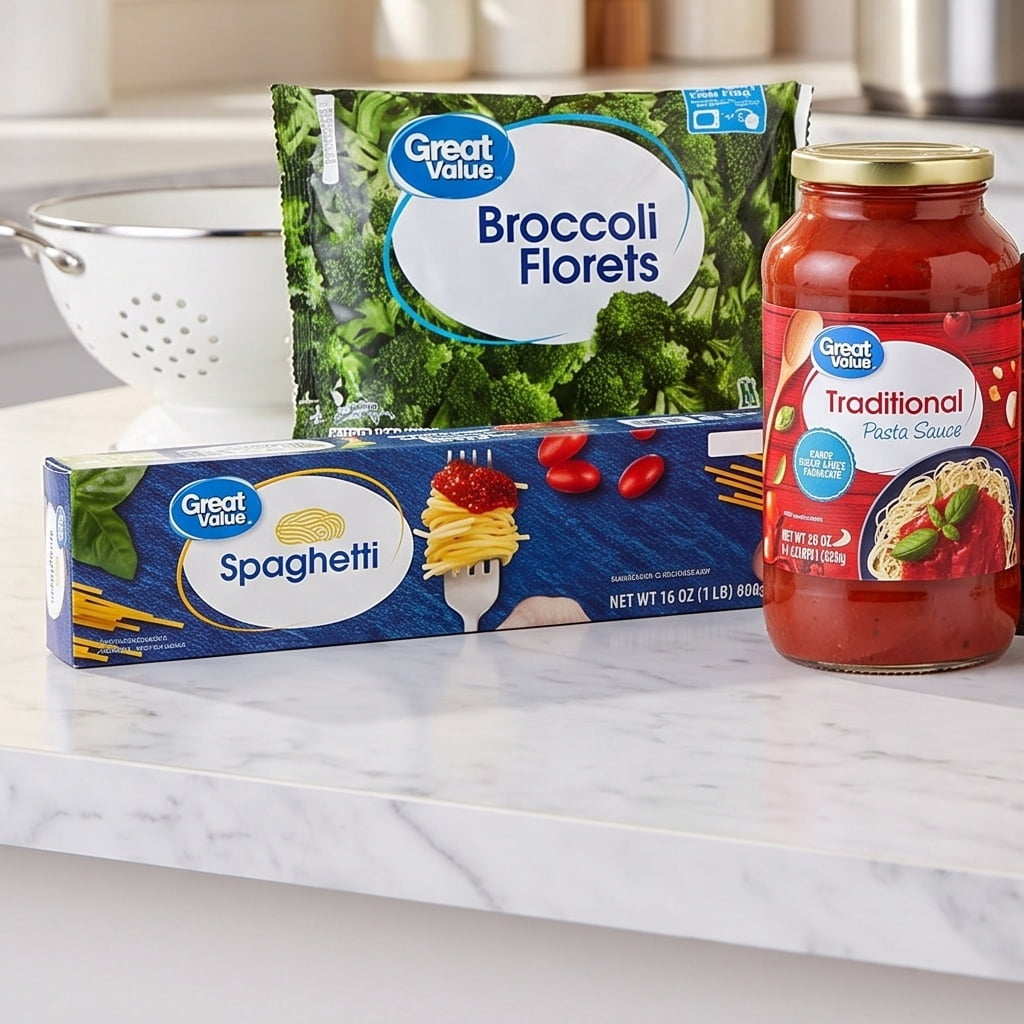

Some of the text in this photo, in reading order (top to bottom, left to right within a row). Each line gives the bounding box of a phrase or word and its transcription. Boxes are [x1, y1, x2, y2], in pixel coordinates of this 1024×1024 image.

[404, 132, 494, 162] Great
[426, 161, 494, 180] Value
[478, 202, 658, 244] Broccoli
[520, 245, 659, 284] Florets
[819, 337, 872, 358] Great
[831, 355, 871, 370] Value
[826, 389, 963, 415] Traditional
[863, 420, 962, 440] Pasta Sauce
[181, 492, 246, 515] Great
[198, 510, 246, 527] Value
[795, 531, 807, 544] WT
[820, 534, 832, 547] OZ
[220, 541, 379, 586] Spaghetti
[610, 593, 634, 609] NET
[637, 591, 657, 607] WT
[660, 590, 675, 604] 16
[678, 588, 694, 603] OZ
[697, 586, 709, 603] (1
[713, 584, 733, 601] LB)
